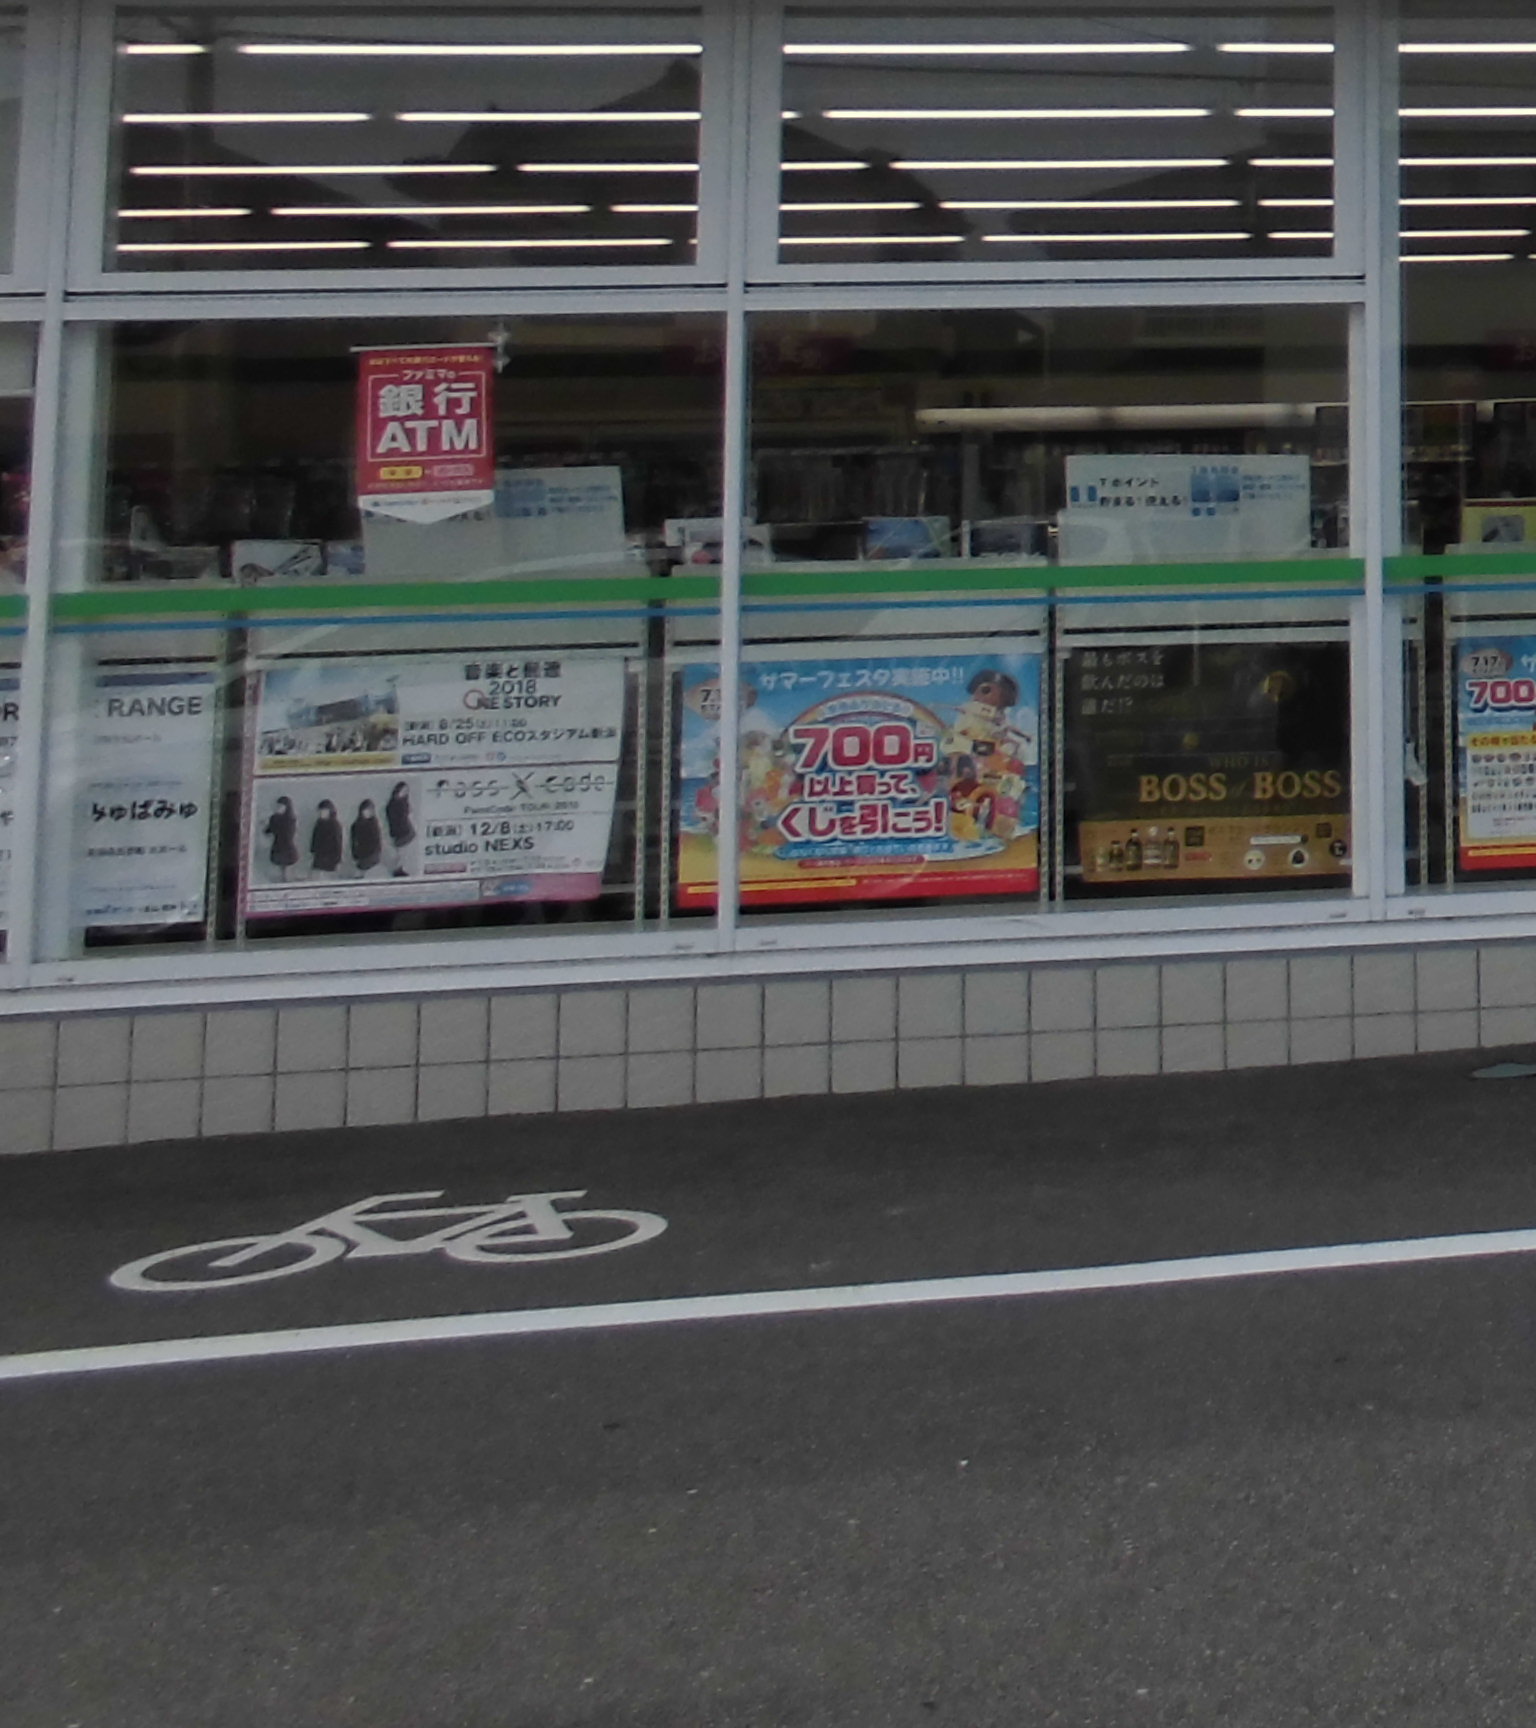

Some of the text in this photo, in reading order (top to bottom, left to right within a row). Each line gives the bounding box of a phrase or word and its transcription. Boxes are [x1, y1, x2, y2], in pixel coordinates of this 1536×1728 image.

[377, 381, 478, 419] 銀行
[375, 418, 479, 454] ATM
[489, 680, 538, 696] 2018
[106, 695, 204, 718] RANGE
[503, 695, 563, 710] STORY
[402, 732, 450, 746] HARD
[455, 730, 488, 745] OFF
[1138, 772, 1229, 804] BOSS
[1253, 770, 1342, 800] BOSS
[424, 835, 536, 857] studio NEXS
